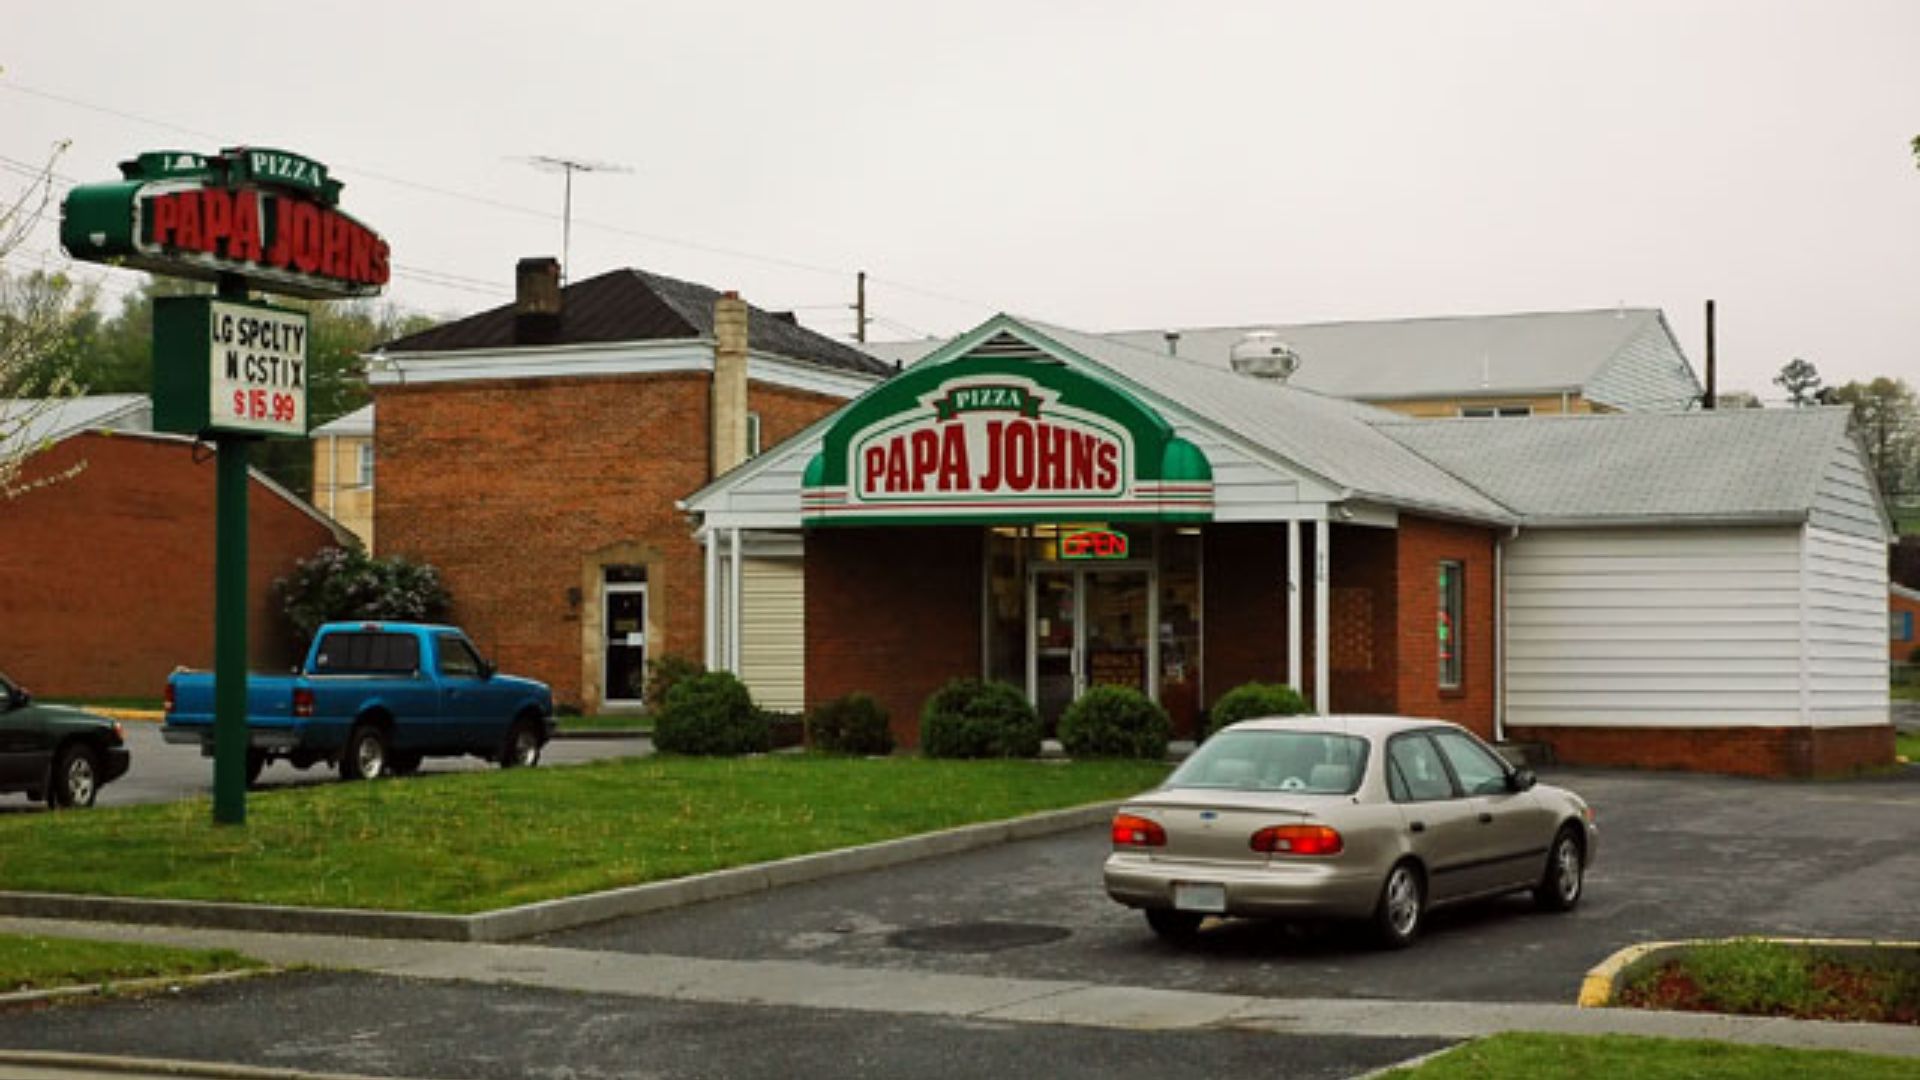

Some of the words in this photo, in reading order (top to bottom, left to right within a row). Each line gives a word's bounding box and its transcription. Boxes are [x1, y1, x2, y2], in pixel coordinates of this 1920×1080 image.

[251, 152, 322, 188] PIZZA
[153, 186, 263, 262] PAPA
[213, 312, 233, 343] LG
[238, 317, 304, 354] SPCLTY
[226, 350, 238, 379] N
[246, 354, 303, 390] CSTIX
[955, 388, 1021, 409] PIZZA
[865, 422, 971, 493] PAPA
[1063, 531, 1127, 556] OPEN
